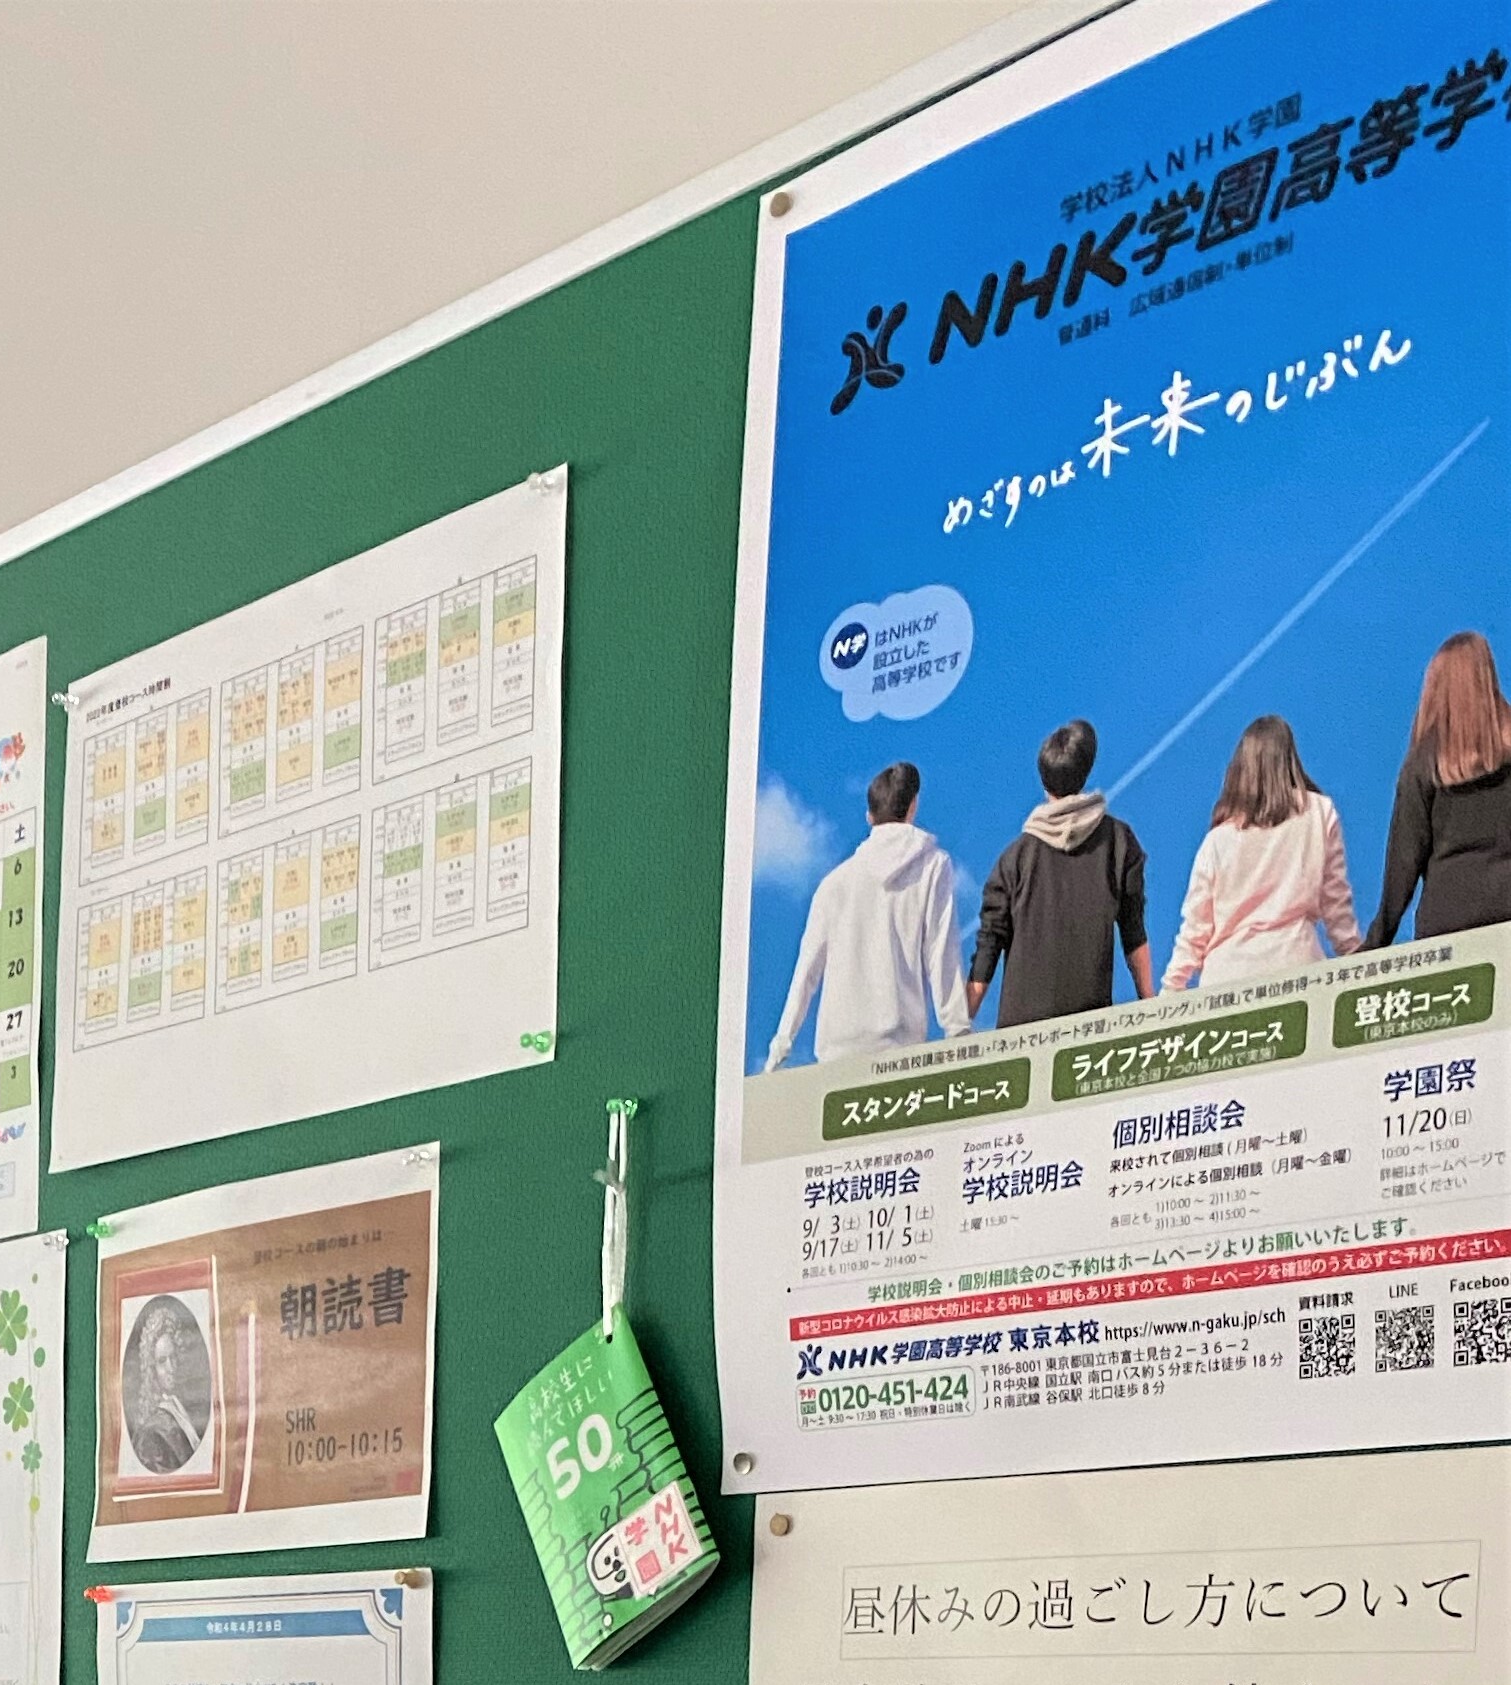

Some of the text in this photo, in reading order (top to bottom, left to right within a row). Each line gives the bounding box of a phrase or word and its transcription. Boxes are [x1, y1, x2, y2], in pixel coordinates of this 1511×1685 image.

[929, 48, 1511, 366] NHK学園高等学
[942, 329, 1411, 534] めざすのは未来のじぶん
[14, 823, 26, 843] 土
[8, 908, 23, 928] 13
[7, 958, 25, 979] 20
[6, 1010, 23, 1031] 27
[1354, 983, 1471, 1027] 登校コース
[1071, 1022, 1285, 1080] ライフデザインコース
[1383, 1058, 1478, 1103] 学園祭
[841, 1080, 1010, 1126] スタンダードコース
[1112, 1100, 1246, 1149] 個別相談会
[963, 1150, 1034, 1174] オンライン
[1379, 1150, 1507, 1182] 詳細はホームページで
[804, 1167, 920, 1209] 学校説明会
[962, 1160, 1084, 1205] 学校説明会
[1381, 1177, 1467, 1200] ご確認ください
[1298, 1291, 1354, 1311] 資料請求
[1389, 1283, 1419, 1298] LINE
[1449, 1275, 1511, 1293] Faceboo
[279, 1266, 411, 1341] 朝読書
[828, 1307, 1286, 1371] NHK学園高等学校 東京本校 https://www.n-gaku.jp/sch
[818, 1374, 969, 1413] 0120-451-424
[1045, 1372, 1082, 1388] 国立駅
[1046, 1388, 1082, 1404] 谷保駅
[285, 1407, 316, 1433] SHR
[843, 1573, 1471, 1637] 昼休みの過ごし方について
